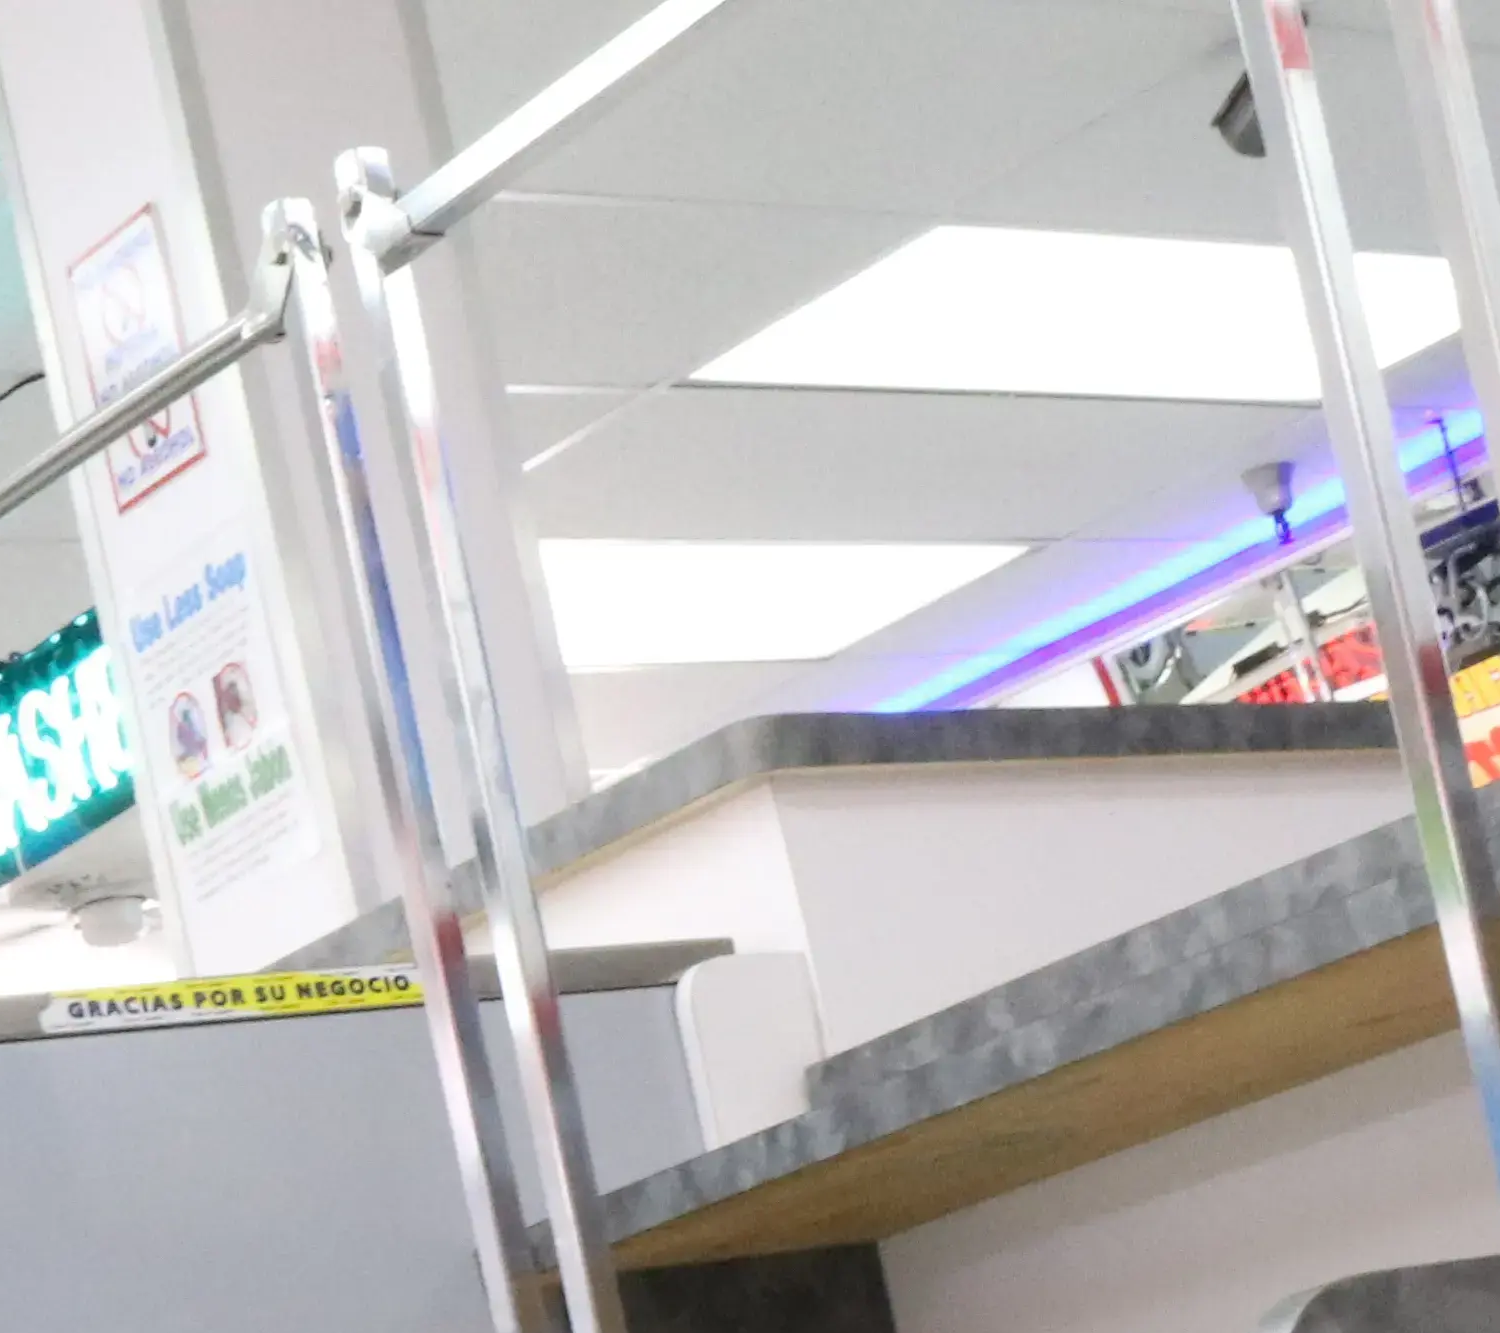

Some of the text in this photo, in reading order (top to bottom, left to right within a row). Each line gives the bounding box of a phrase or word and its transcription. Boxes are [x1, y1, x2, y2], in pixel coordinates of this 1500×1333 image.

[162, 583, 203, 633] Less
[204, 552, 246, 600] Soap
[68, 974, 411, 1020] GRACIAS POR SU NEGOCIO
